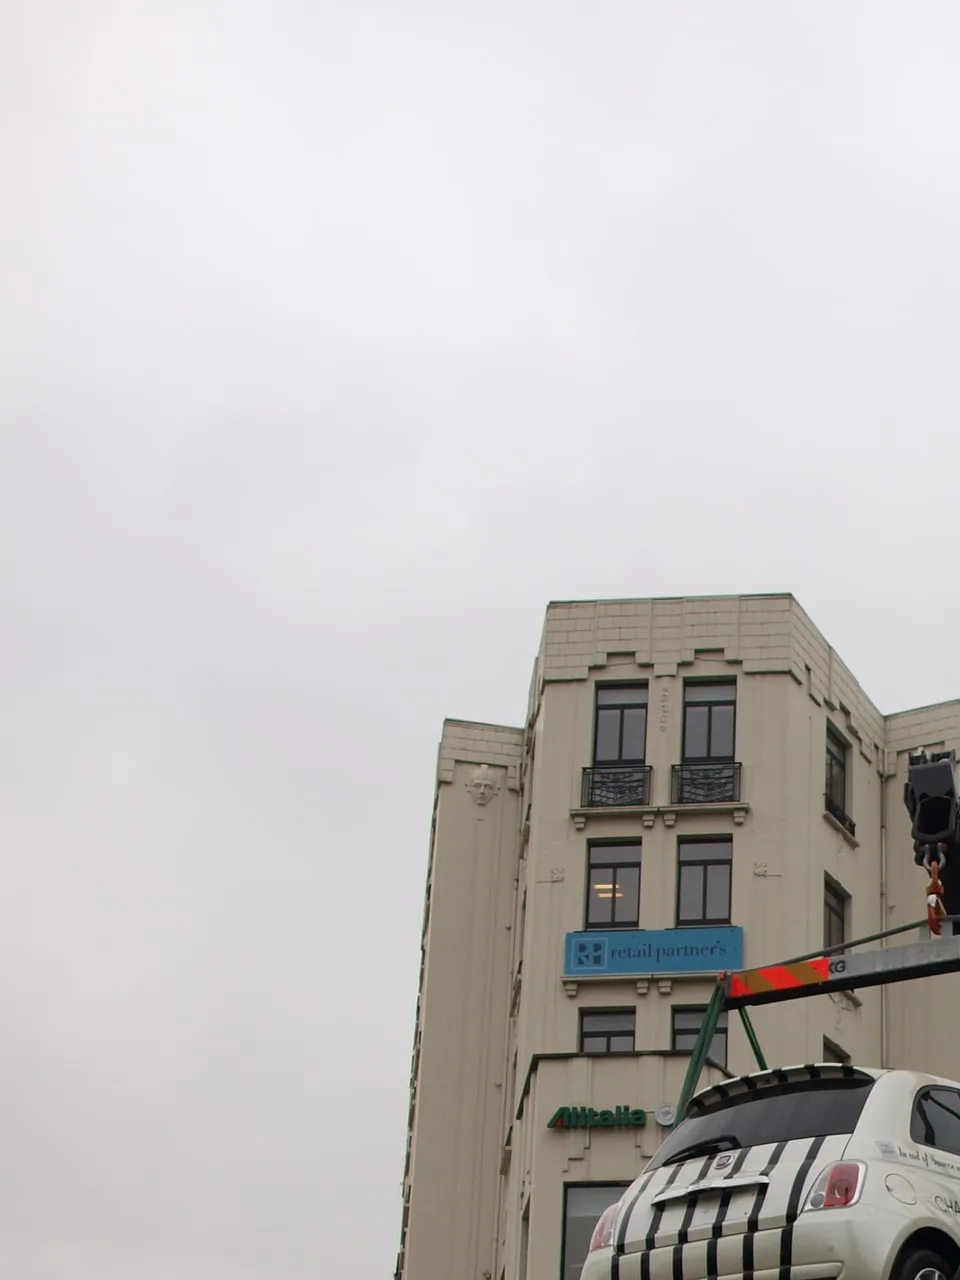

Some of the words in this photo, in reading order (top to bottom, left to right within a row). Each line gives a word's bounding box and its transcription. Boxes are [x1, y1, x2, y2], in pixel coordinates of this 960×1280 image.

[610, 943, 652, 960] retail
[656, 940, 727, 963] partner's
[547, 1105, 646, 1128] Alitalia
